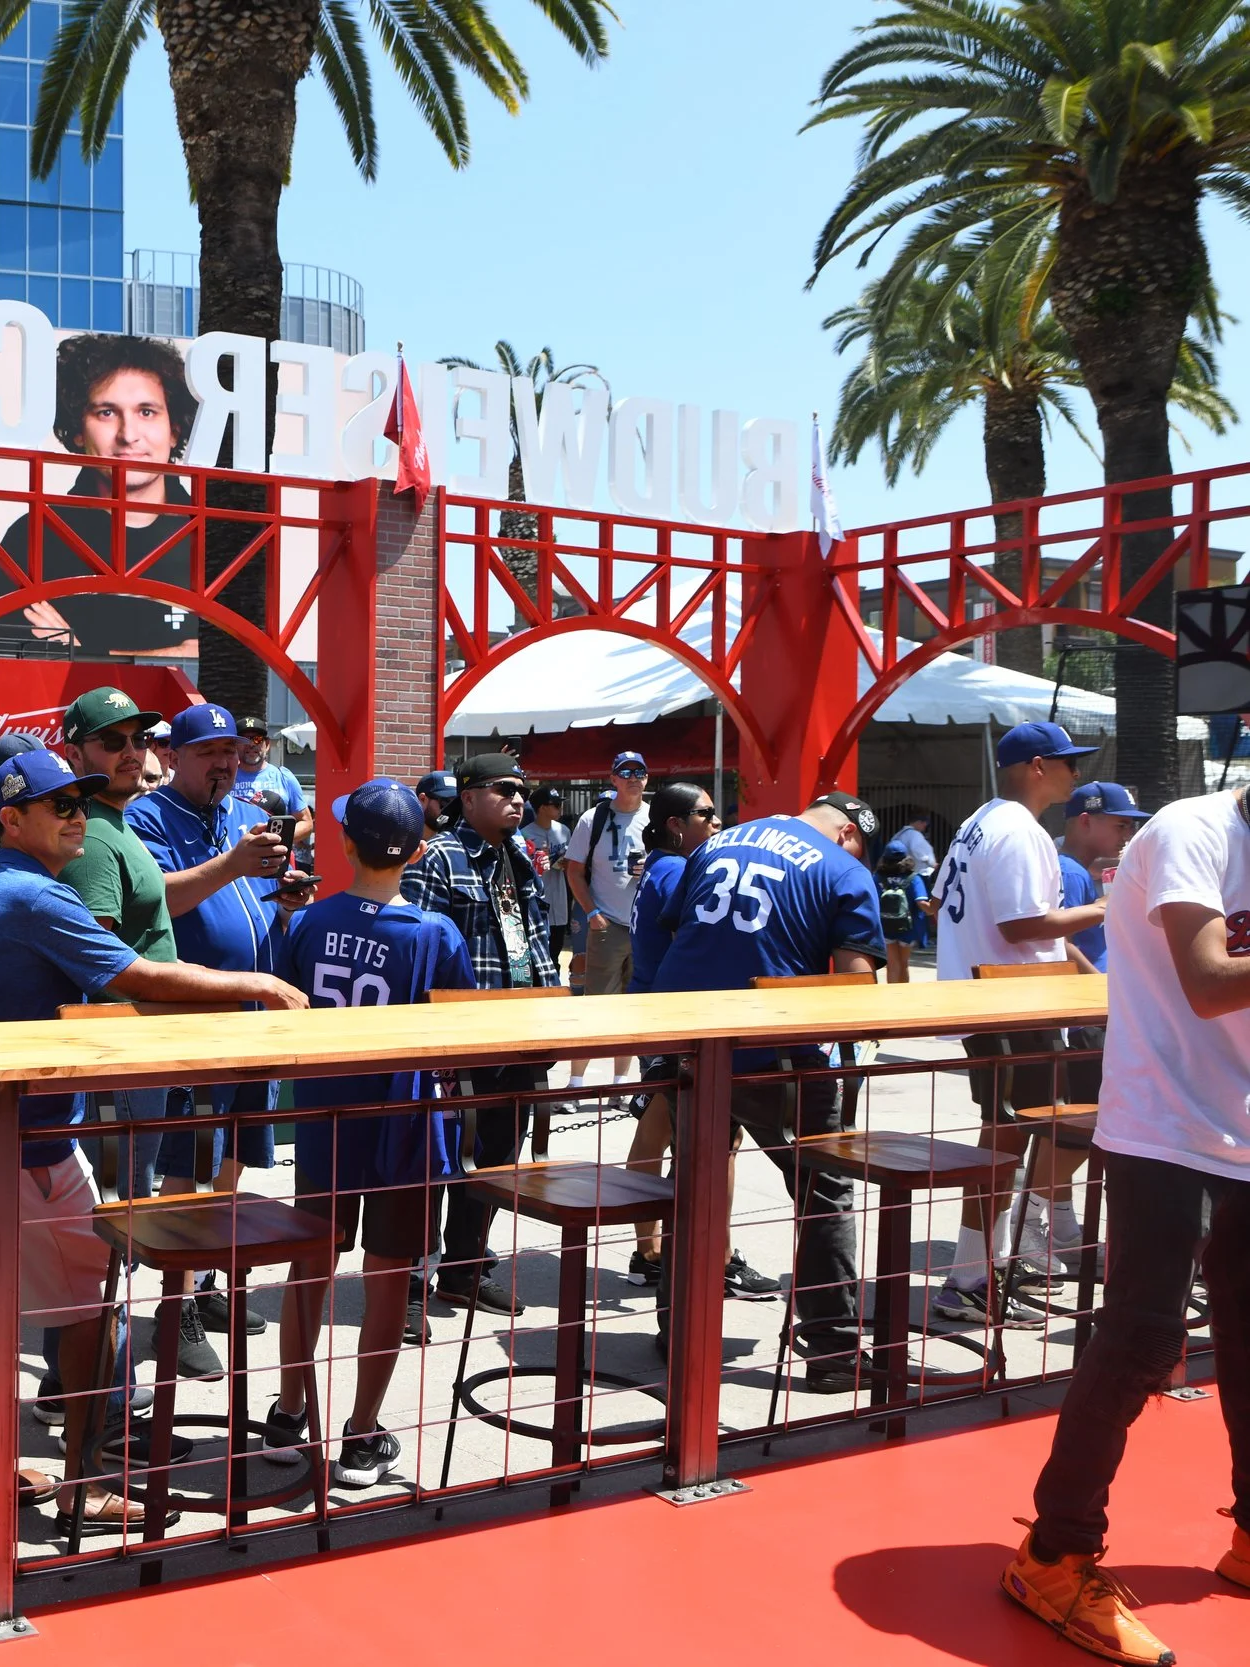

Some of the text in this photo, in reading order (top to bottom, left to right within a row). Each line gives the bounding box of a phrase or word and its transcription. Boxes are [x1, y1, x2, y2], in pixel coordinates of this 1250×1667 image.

[209, 708, 227, 728] LA
[705, 826, 824, 872] BELLINGER
[695, 858, 786, 934] 35
[325, 931, 390, 969] BETTS
[312, 962, 391, 1008] 50
